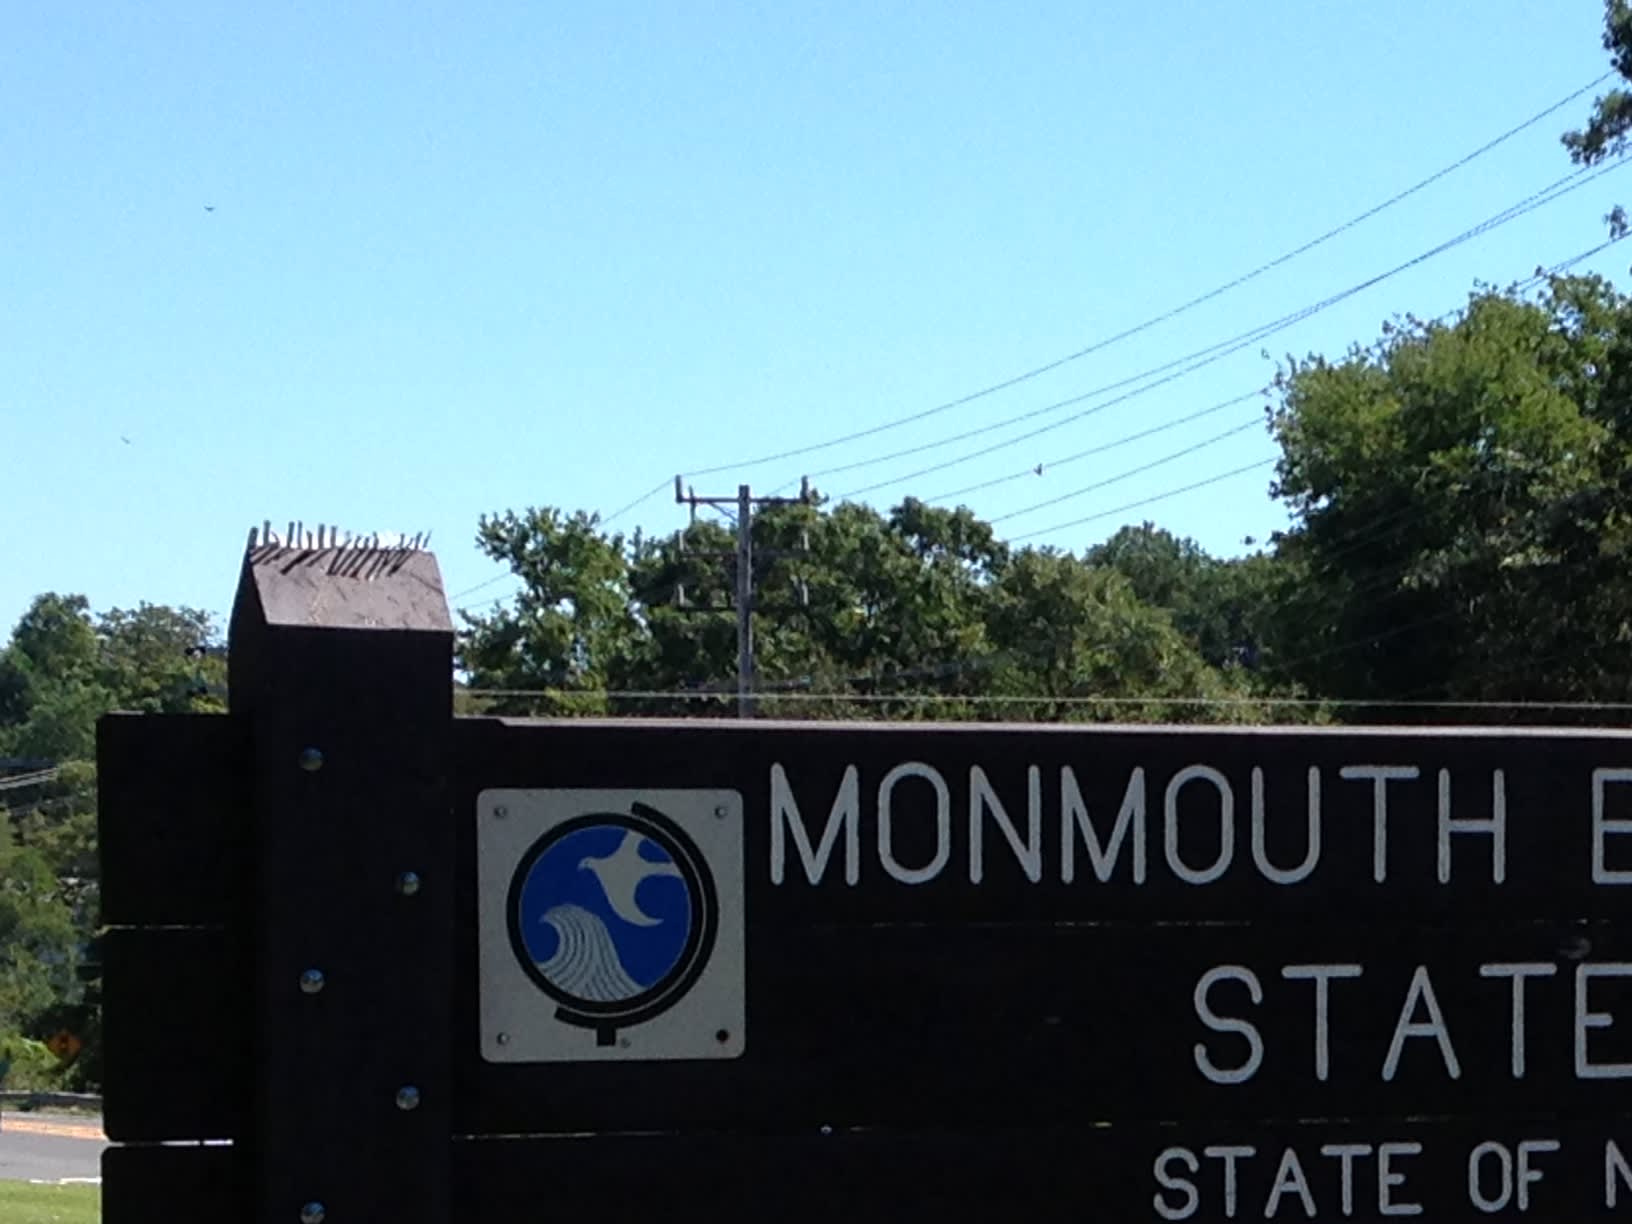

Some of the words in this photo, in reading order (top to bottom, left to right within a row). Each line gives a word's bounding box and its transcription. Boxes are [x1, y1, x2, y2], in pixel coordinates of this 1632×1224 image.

[770, 762, 1506, 887] MONMOUTH
[1152, 1142, 1424, 1221] STATE
[1468, 1139, 1561, 1213] OF
